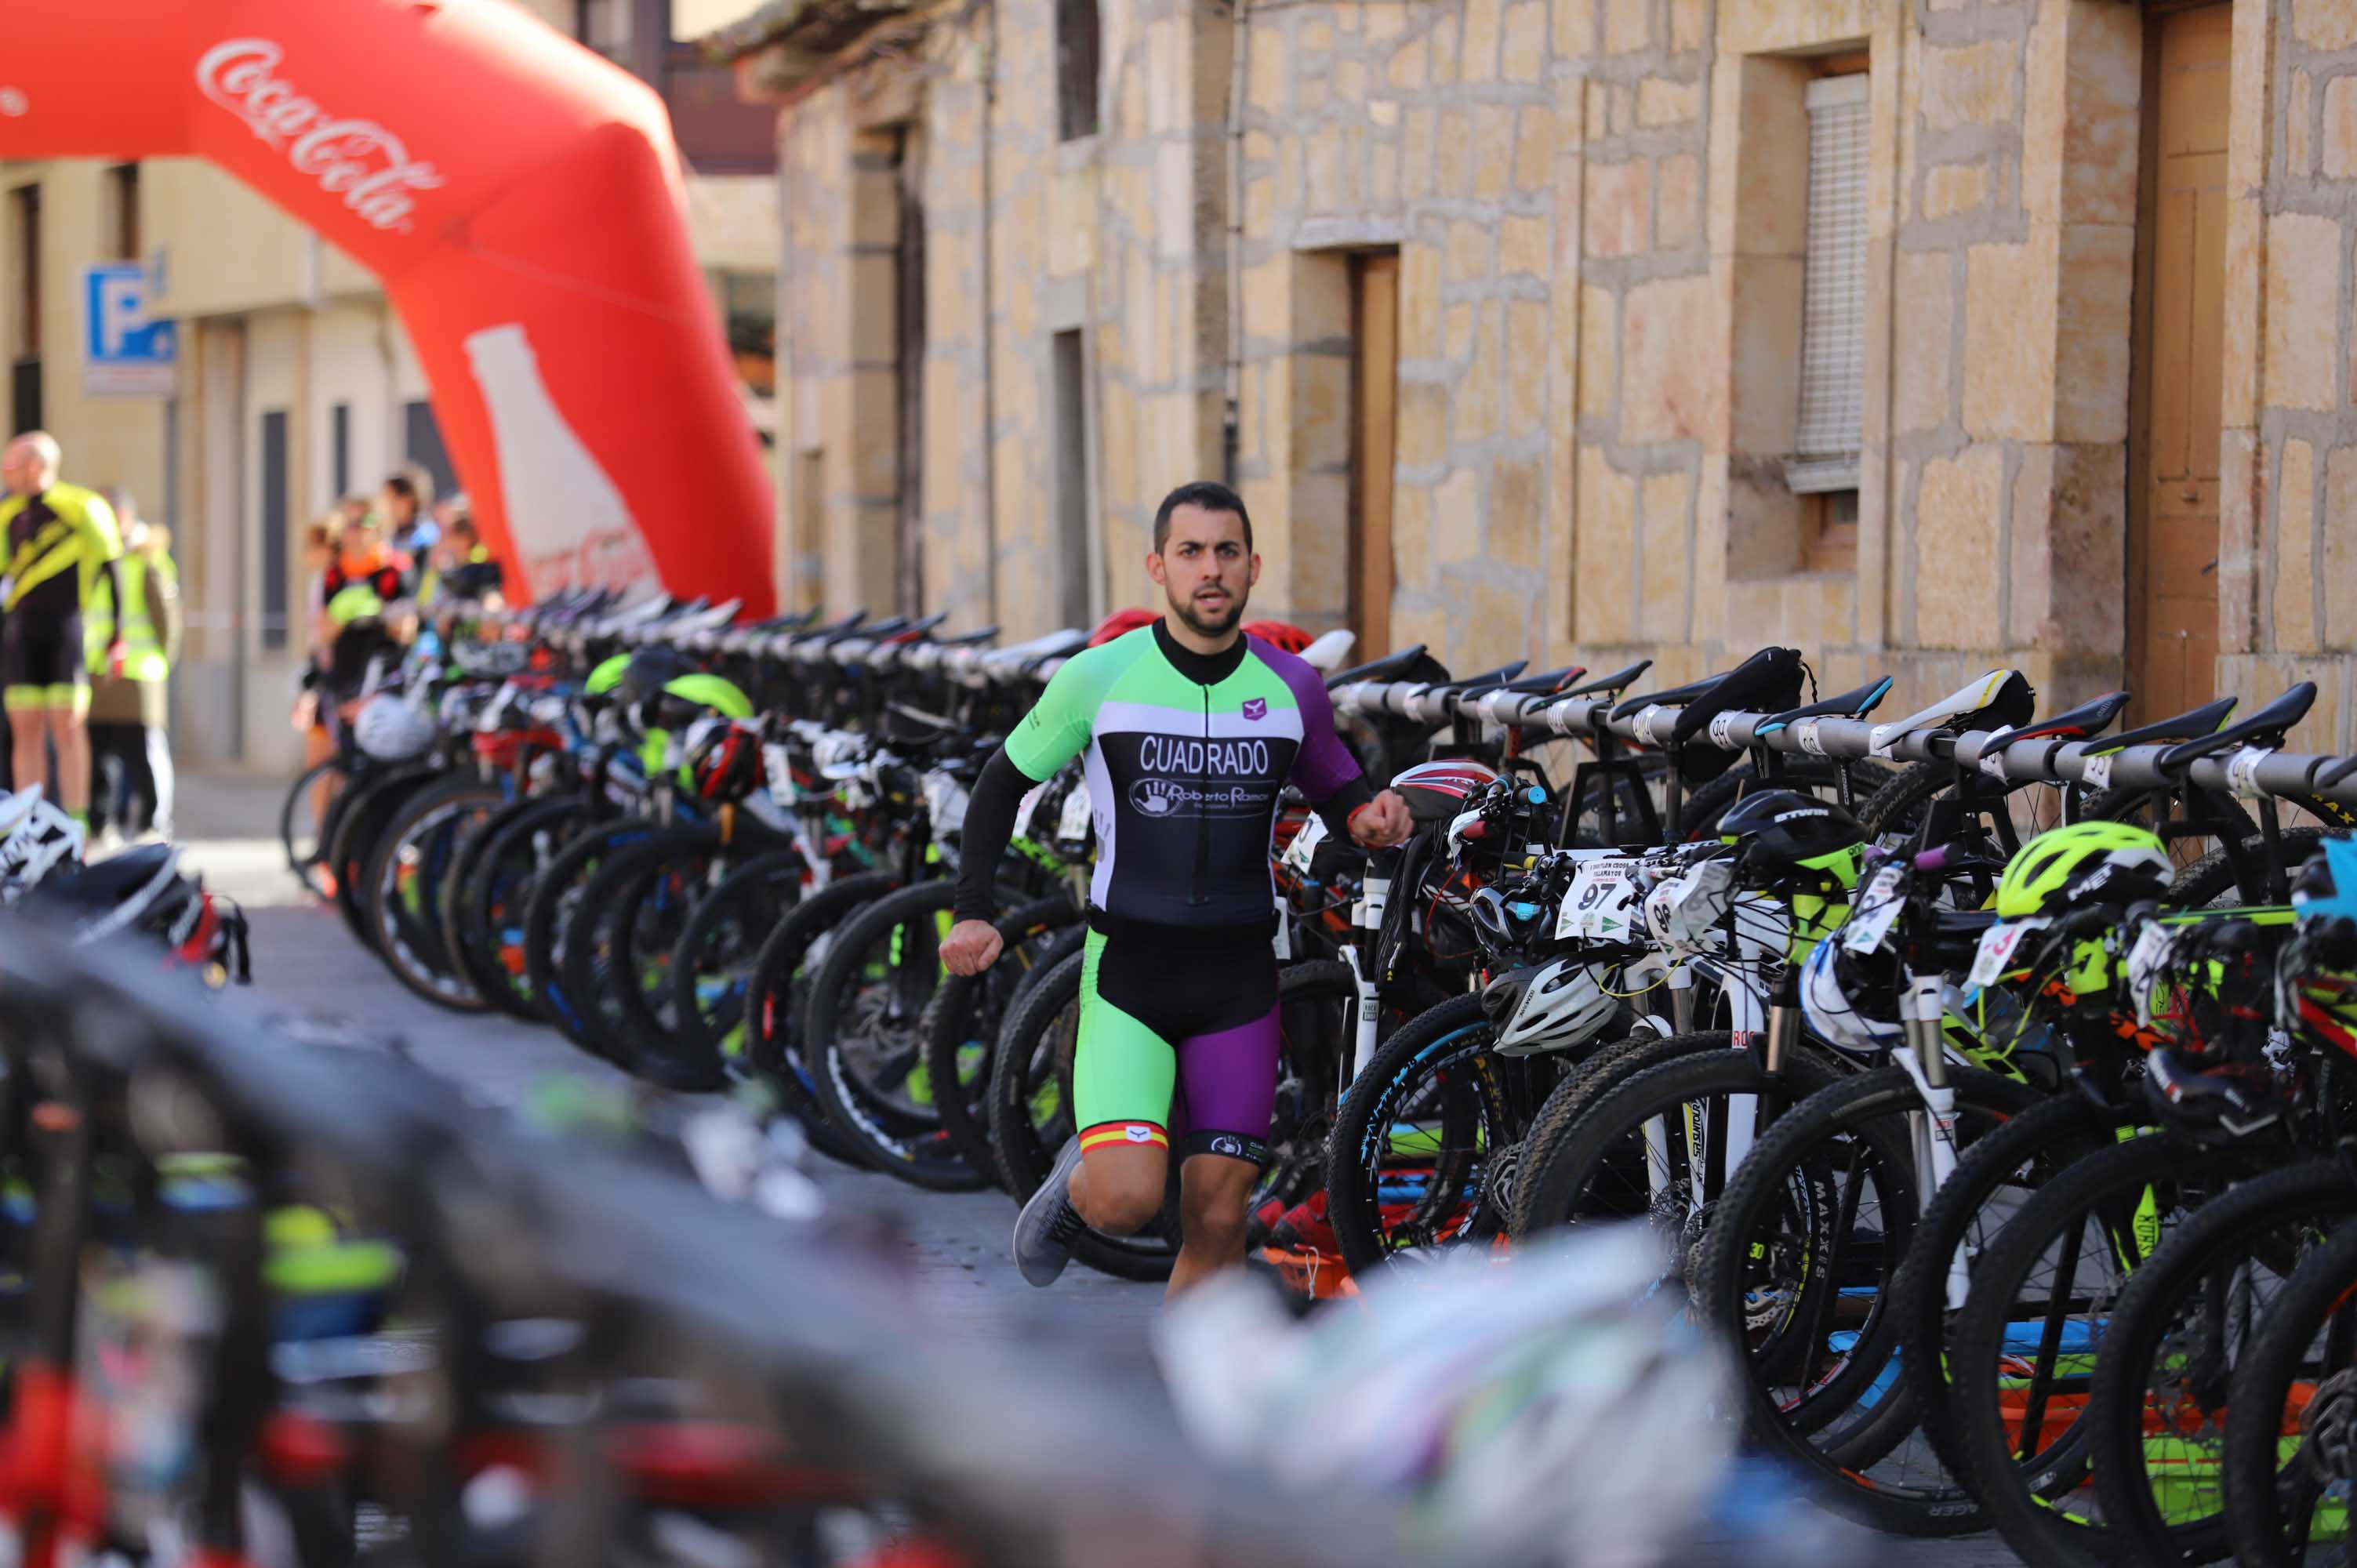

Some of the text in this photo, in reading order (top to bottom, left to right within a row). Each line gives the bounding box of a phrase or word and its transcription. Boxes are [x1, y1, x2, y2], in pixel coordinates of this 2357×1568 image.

[104, 280, 146, 353] P
[1140, 735, 1269, 775] CUADRADO
[1578, 883, 1617, 910] 97
[1814, 1180, 1829, 1279] MAXXIS
